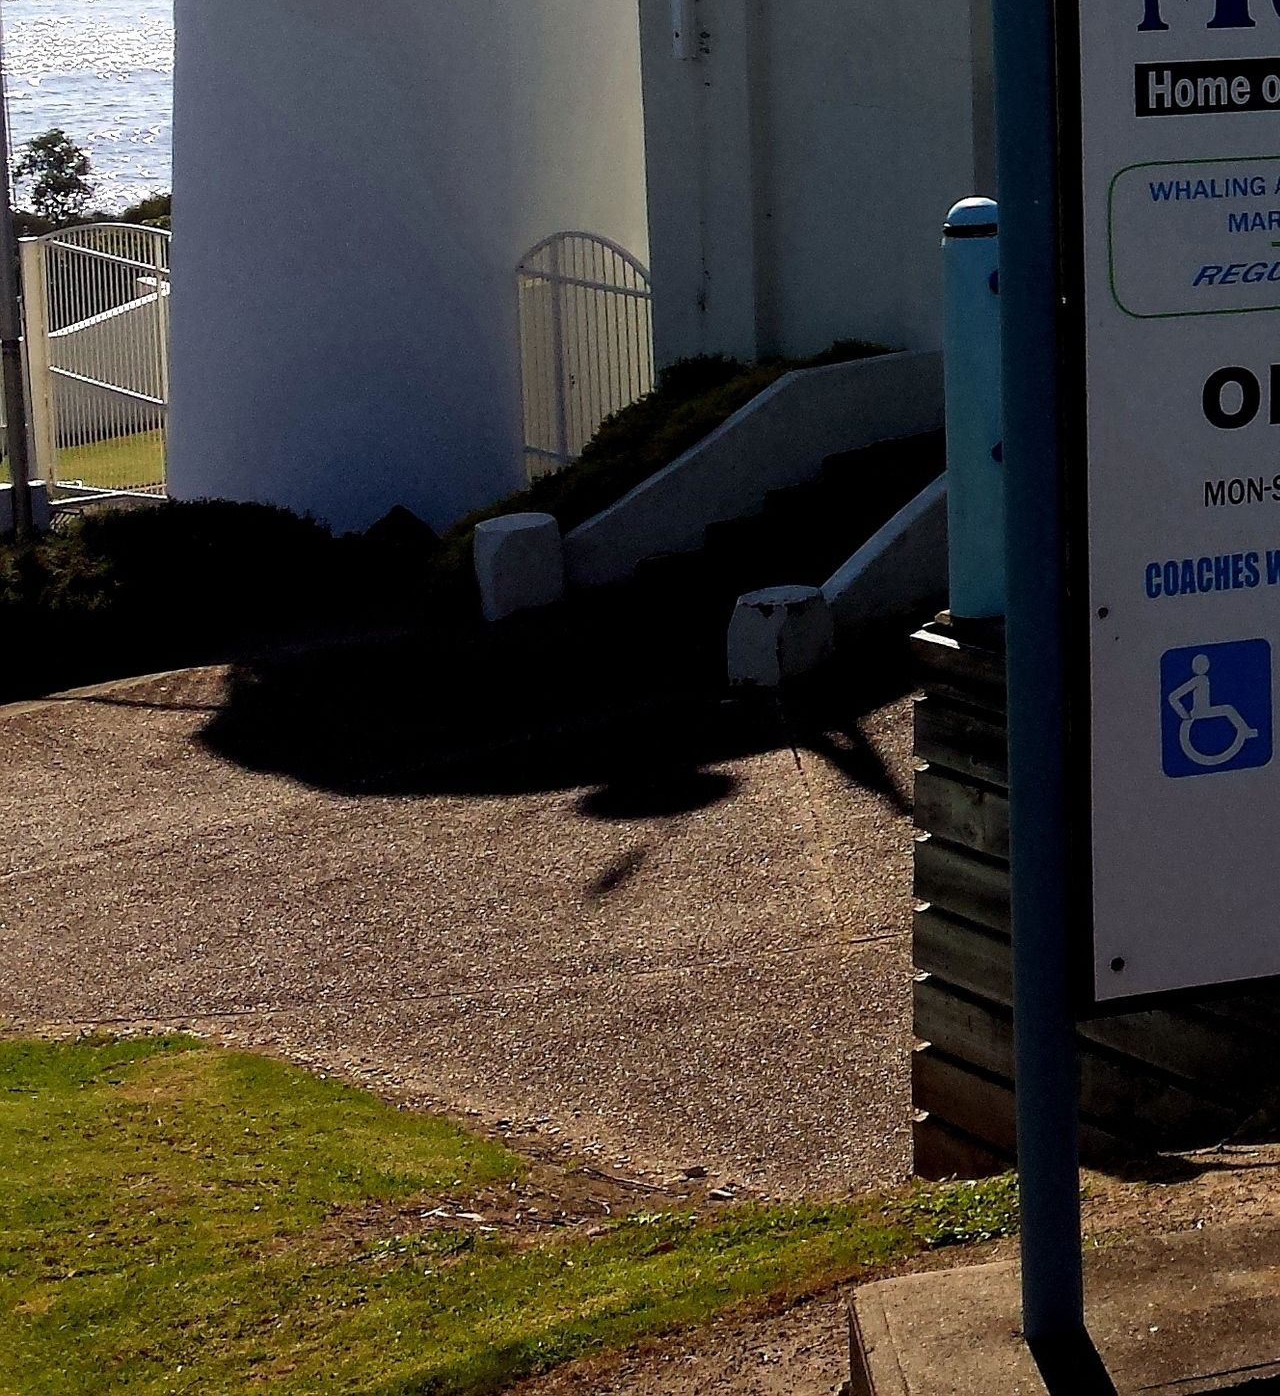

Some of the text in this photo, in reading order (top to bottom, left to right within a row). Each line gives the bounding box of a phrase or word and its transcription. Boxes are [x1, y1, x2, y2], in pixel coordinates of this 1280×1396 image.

[1147, 68, 1251, 109] Home
[1149, 175, 1266, 202] WHALING
[1145, 552, 1261, 599] COACHES
